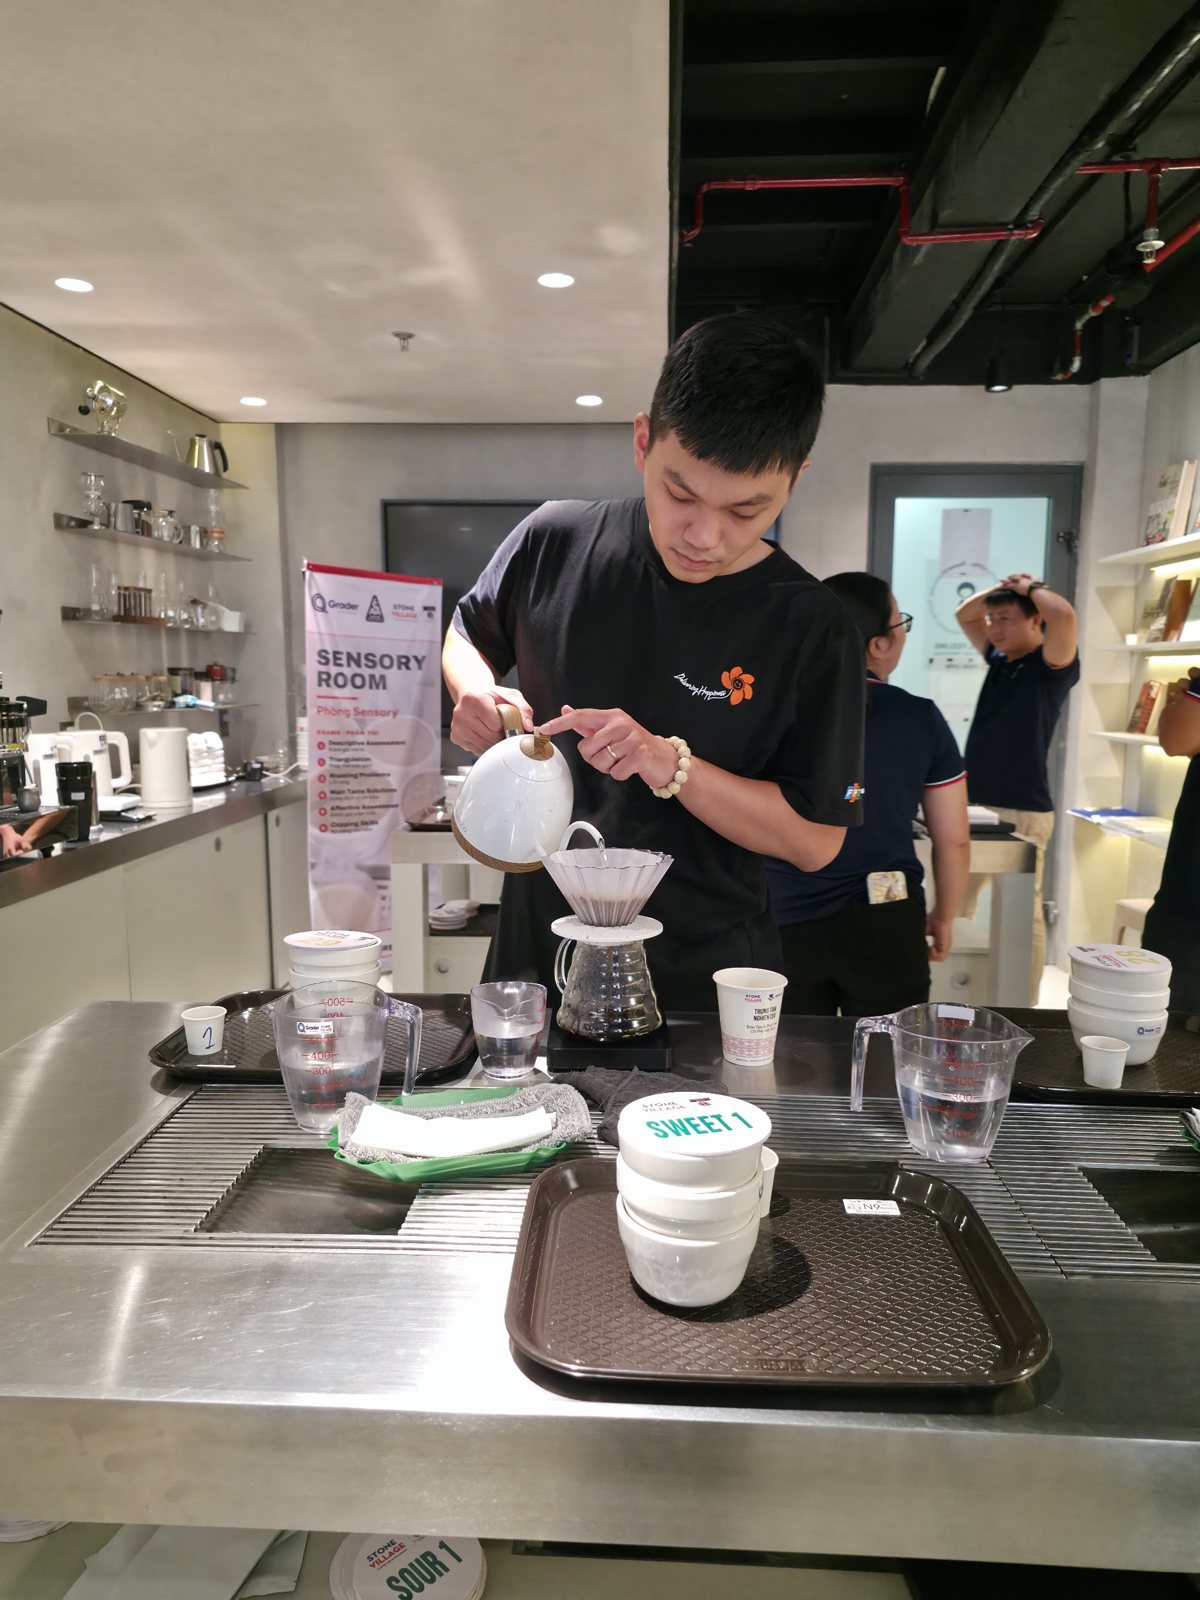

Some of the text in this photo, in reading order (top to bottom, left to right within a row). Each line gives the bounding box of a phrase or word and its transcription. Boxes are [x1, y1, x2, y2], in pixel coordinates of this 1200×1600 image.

[328, 600, 360, 611] Grader
[316, 649, 427, 671] SENSORY
[317, 671, 387, 690] ROOM
[352, 706, 399, 719] Sensory
[311, 1051, 331, 1060] 400
[312, 1066, 332, 1076] 300
[646, 1111, 753, 1139] SWEET 1
[366, 1539, 397, 1562] STONE
[368, 1542, 407, 1569] VILLAGE
[386, 1550, 450, 1600] SOUR
[439, 1539, 463, 1563] 1
